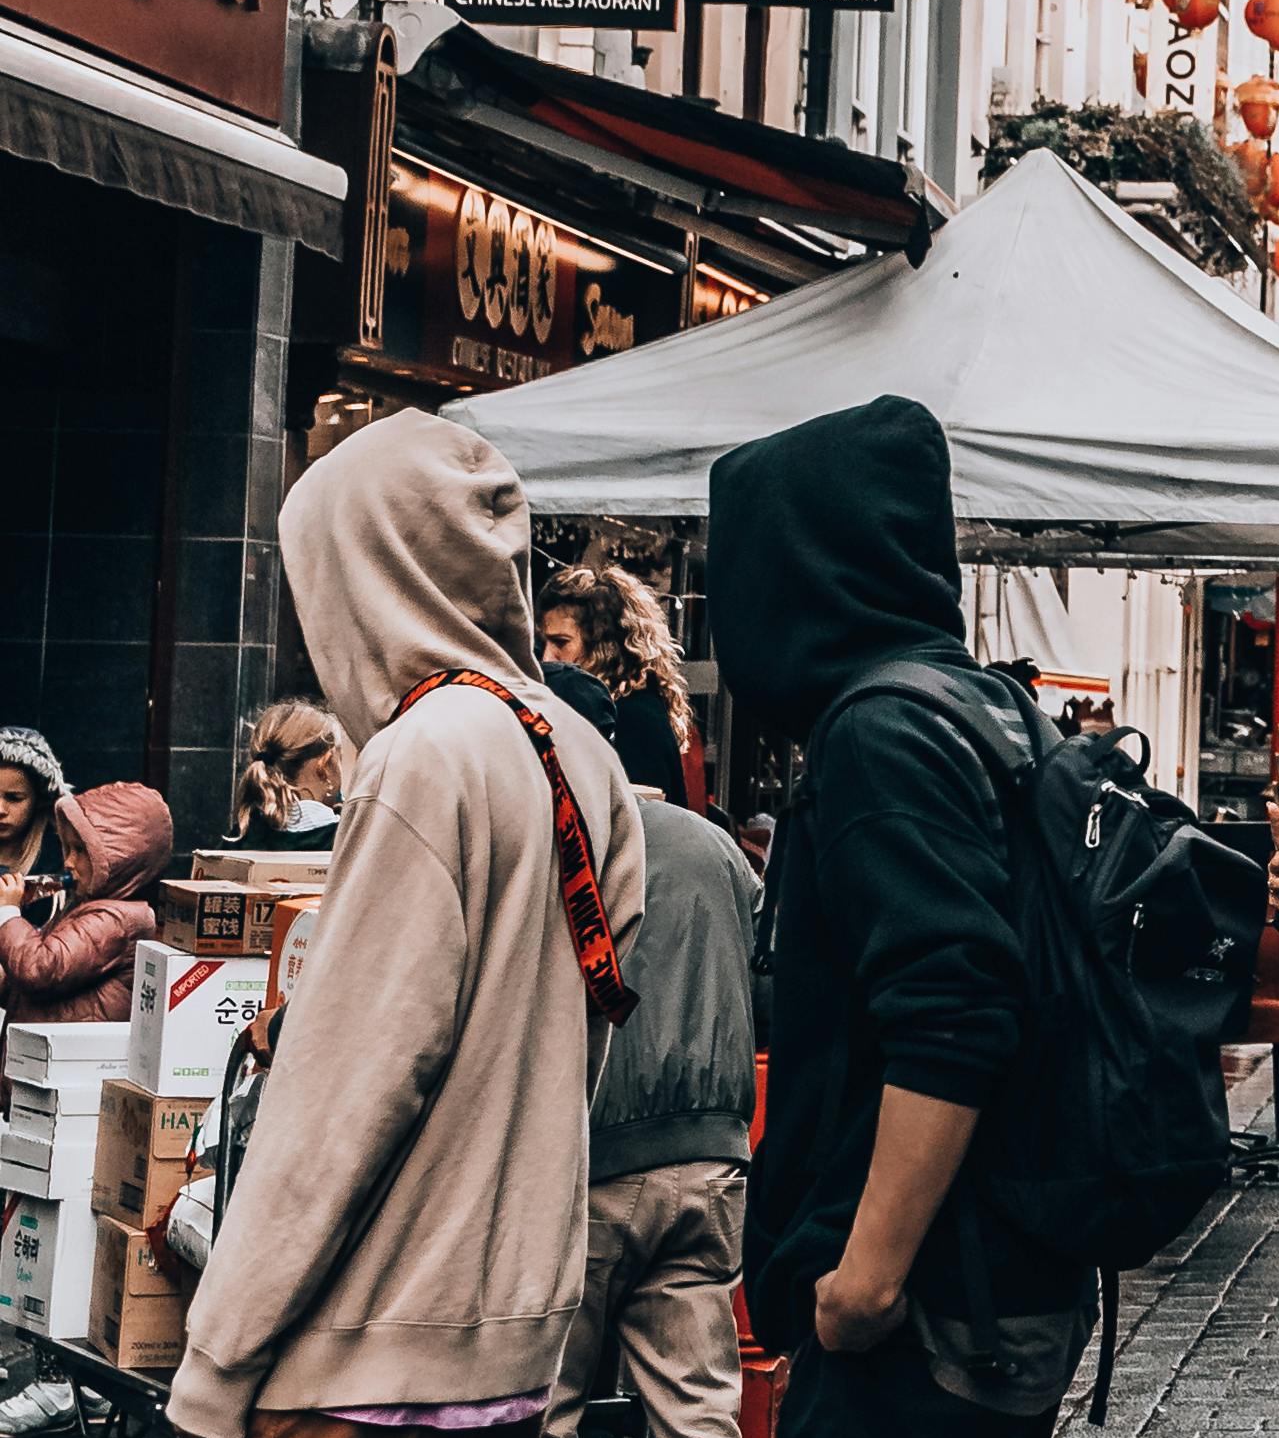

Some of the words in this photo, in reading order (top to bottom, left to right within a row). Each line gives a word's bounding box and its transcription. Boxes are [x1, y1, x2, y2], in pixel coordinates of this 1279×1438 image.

[204, 895, 241, 915] 罐装
[255, 902, 277, 923] 17
[172, 964, 211, 999] IMPORTED
